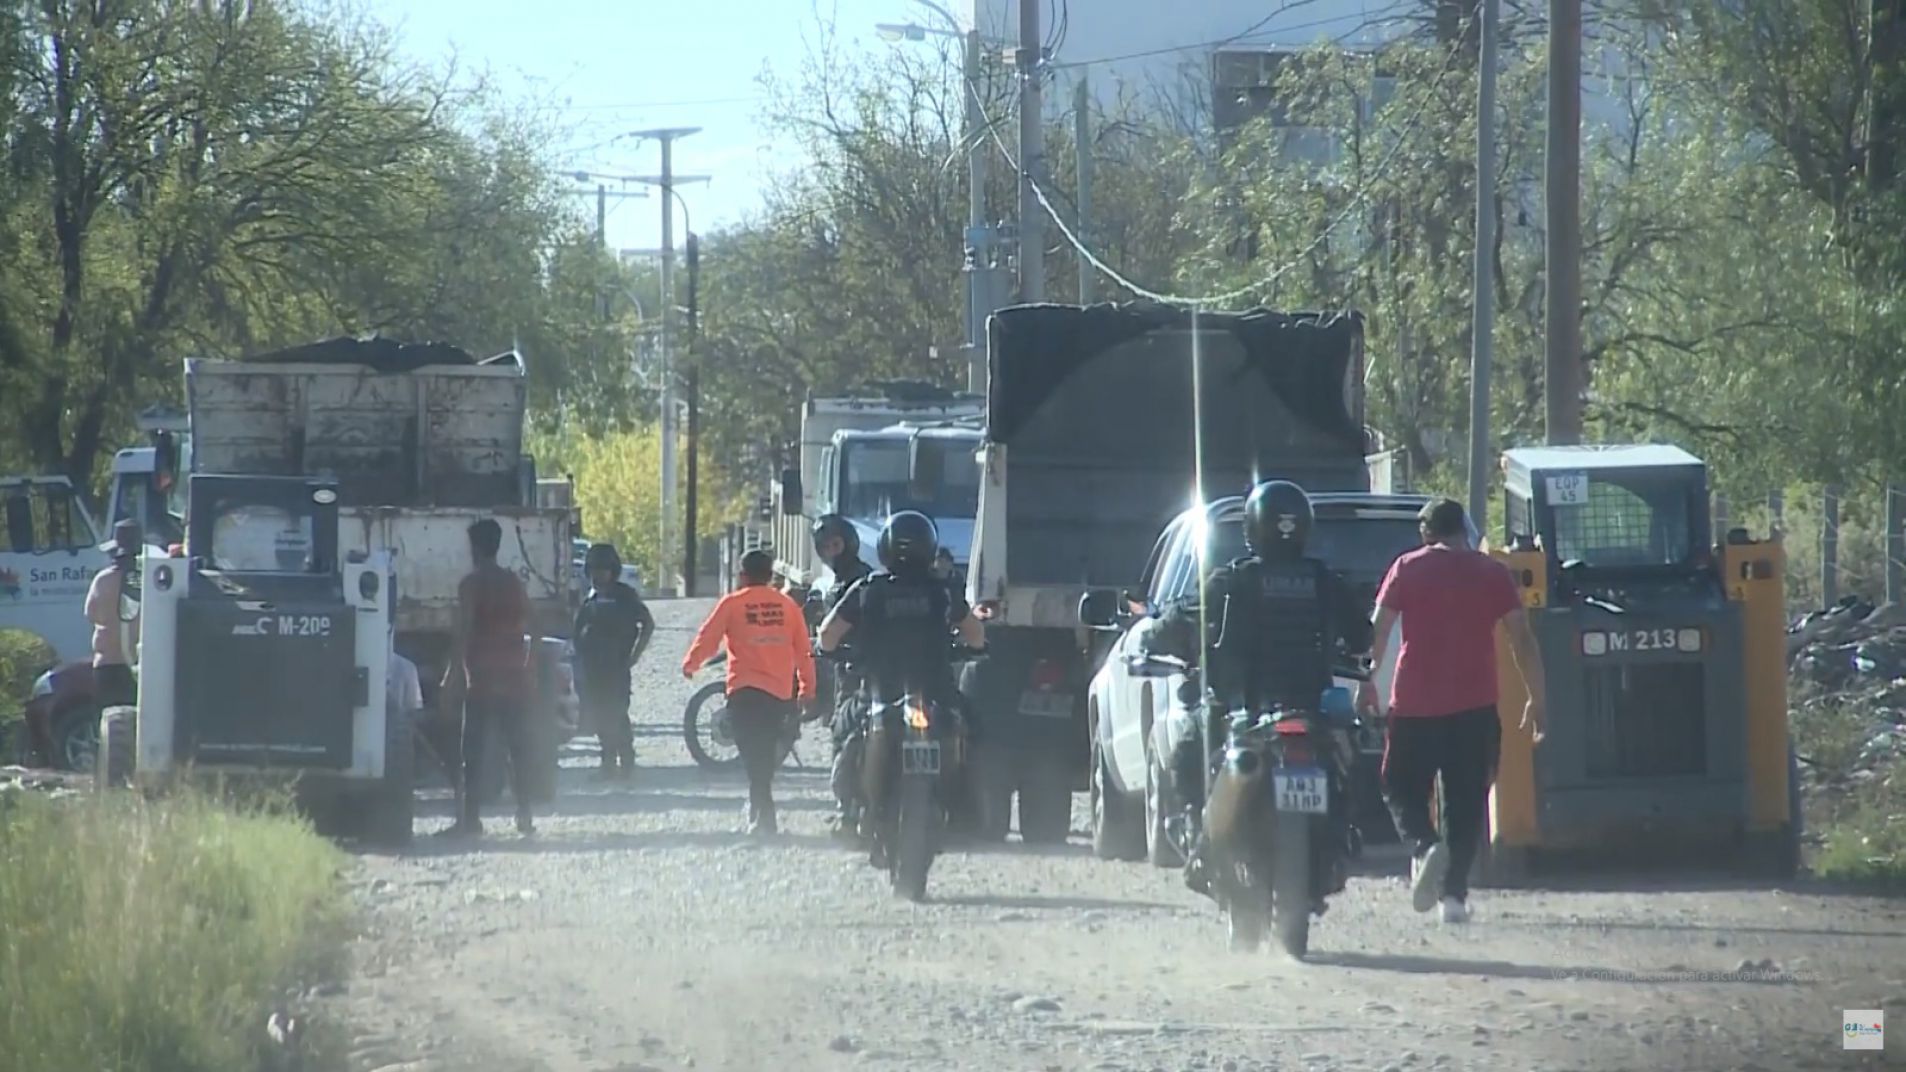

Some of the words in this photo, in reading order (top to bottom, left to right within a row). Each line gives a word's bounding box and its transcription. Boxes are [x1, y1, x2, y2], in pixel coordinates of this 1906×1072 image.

[30, 567, 57, 582] San
[279, 615, 331, 635] M-209
[1609, 631, 1628, 650] M
[1635, 628, 1675, 650] 213
